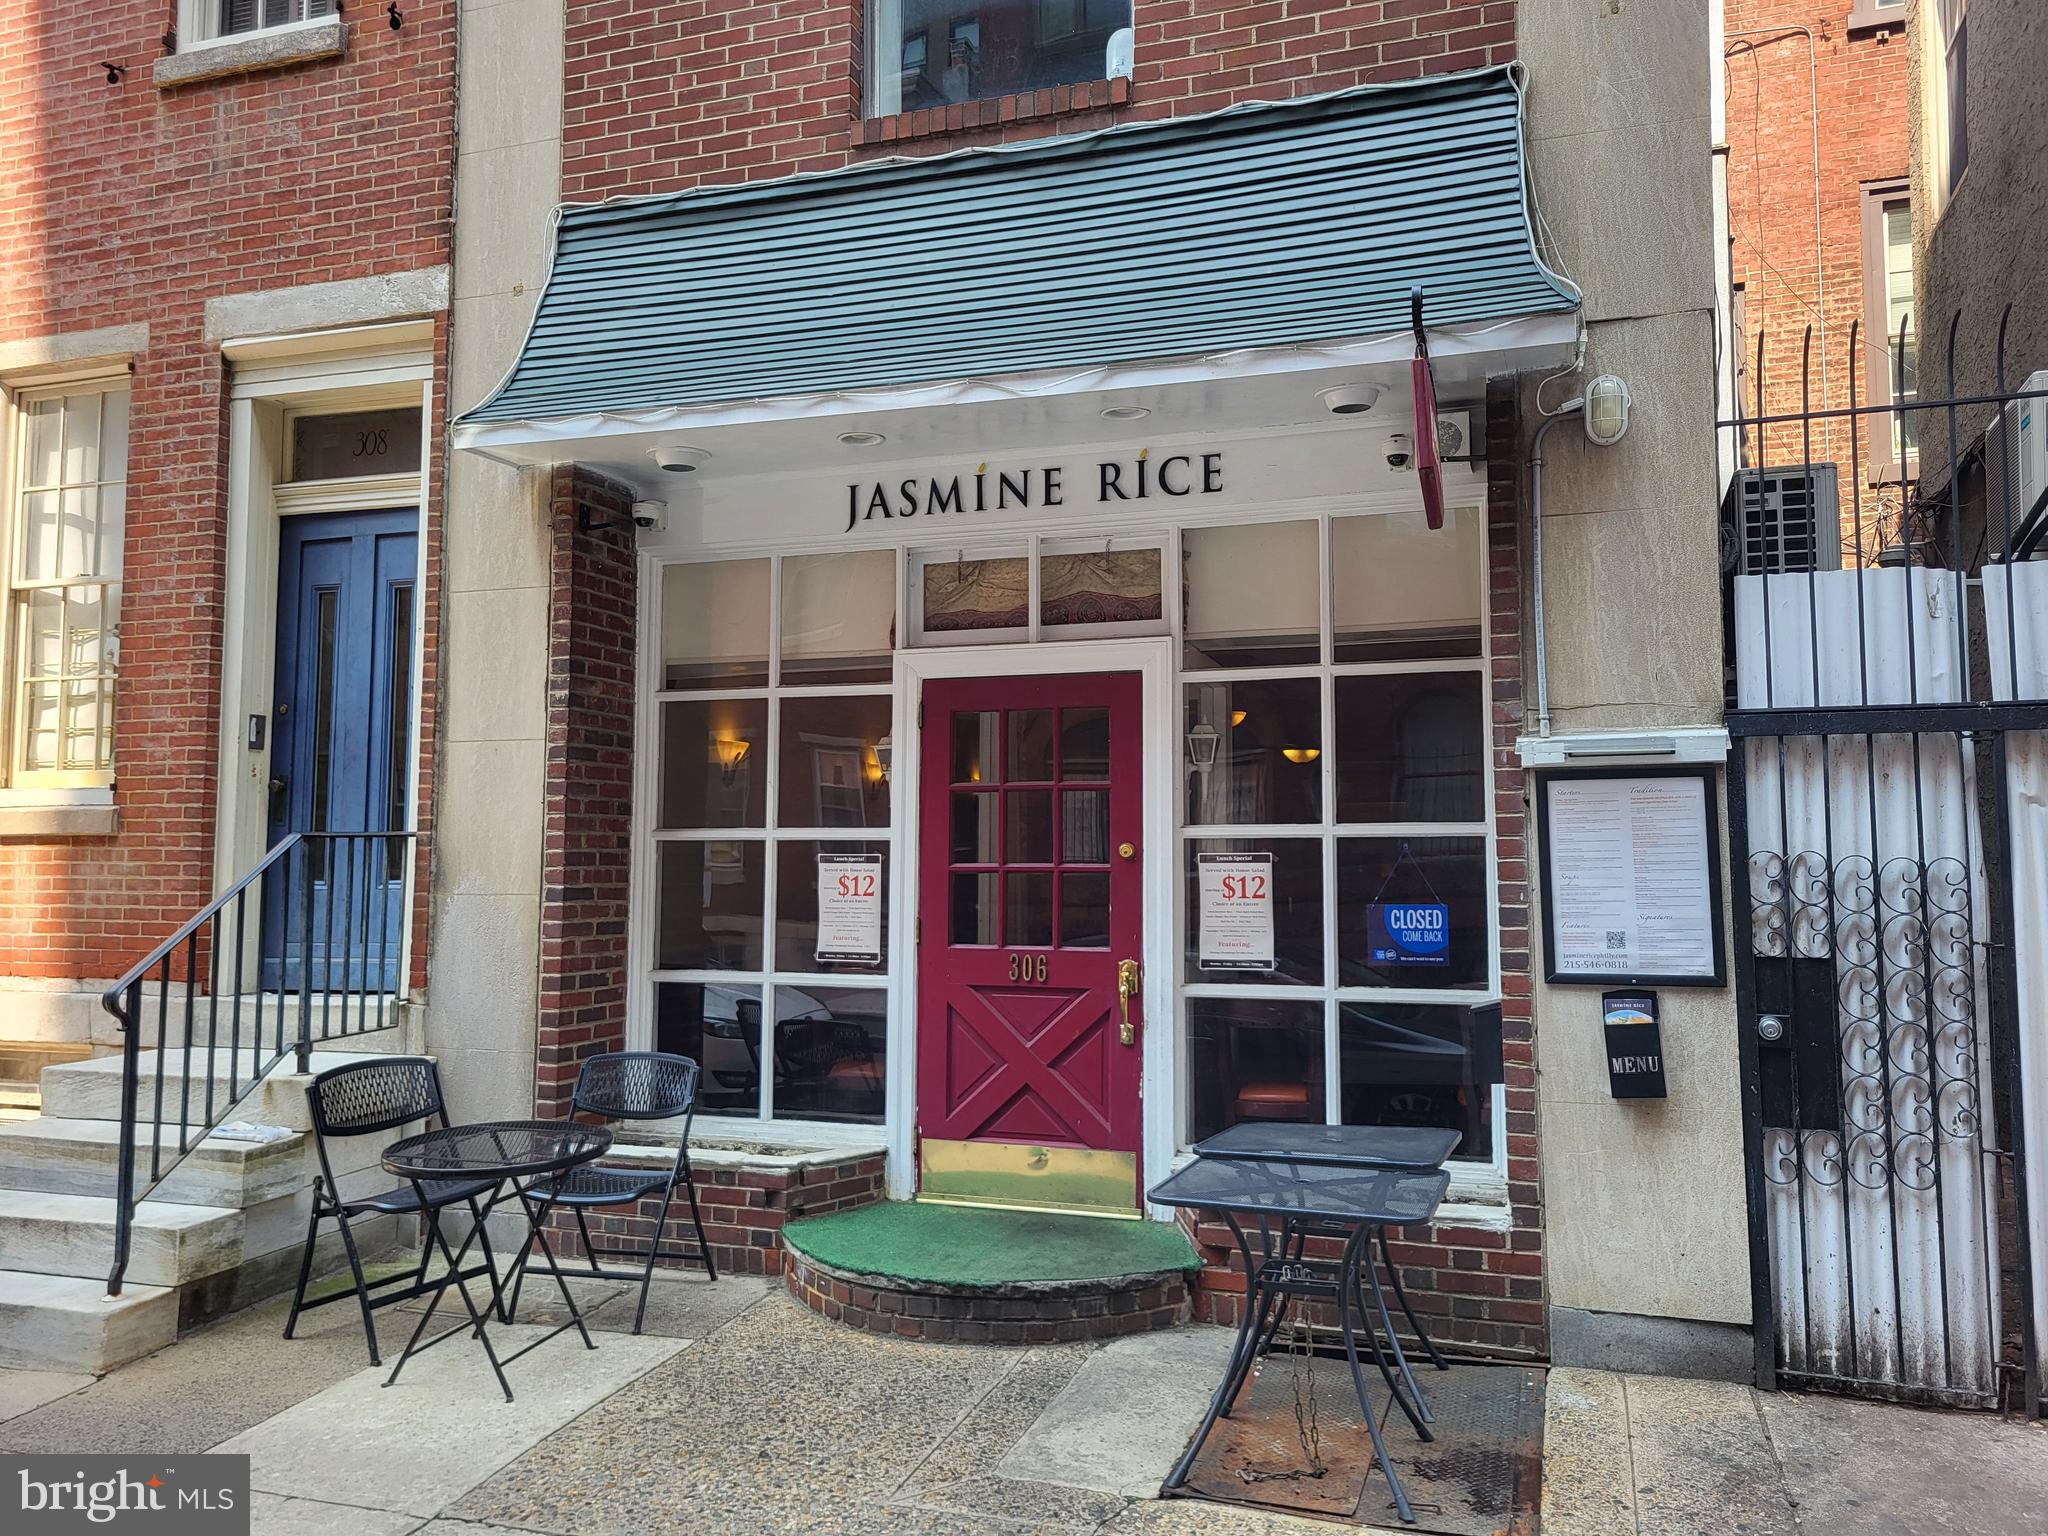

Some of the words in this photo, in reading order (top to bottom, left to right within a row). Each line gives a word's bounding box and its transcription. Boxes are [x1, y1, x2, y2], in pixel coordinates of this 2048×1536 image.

[352, 429, 387, 456] 308
[844, 463, 1063, 533] JASMINE
[1097, 449, 1224, 502] RICE
[838, 873, 875, 899] $12
[1222, 873, 1265, 901] $12
[1391, 909, 1443, 929] CLOSED
[1402, 930, 1423, 942] COME
[1423, 930, 1443, 942] BACK
[1009, 953, 1047, 982] 306
[1612, 1056, 1659, 1074] MENU
